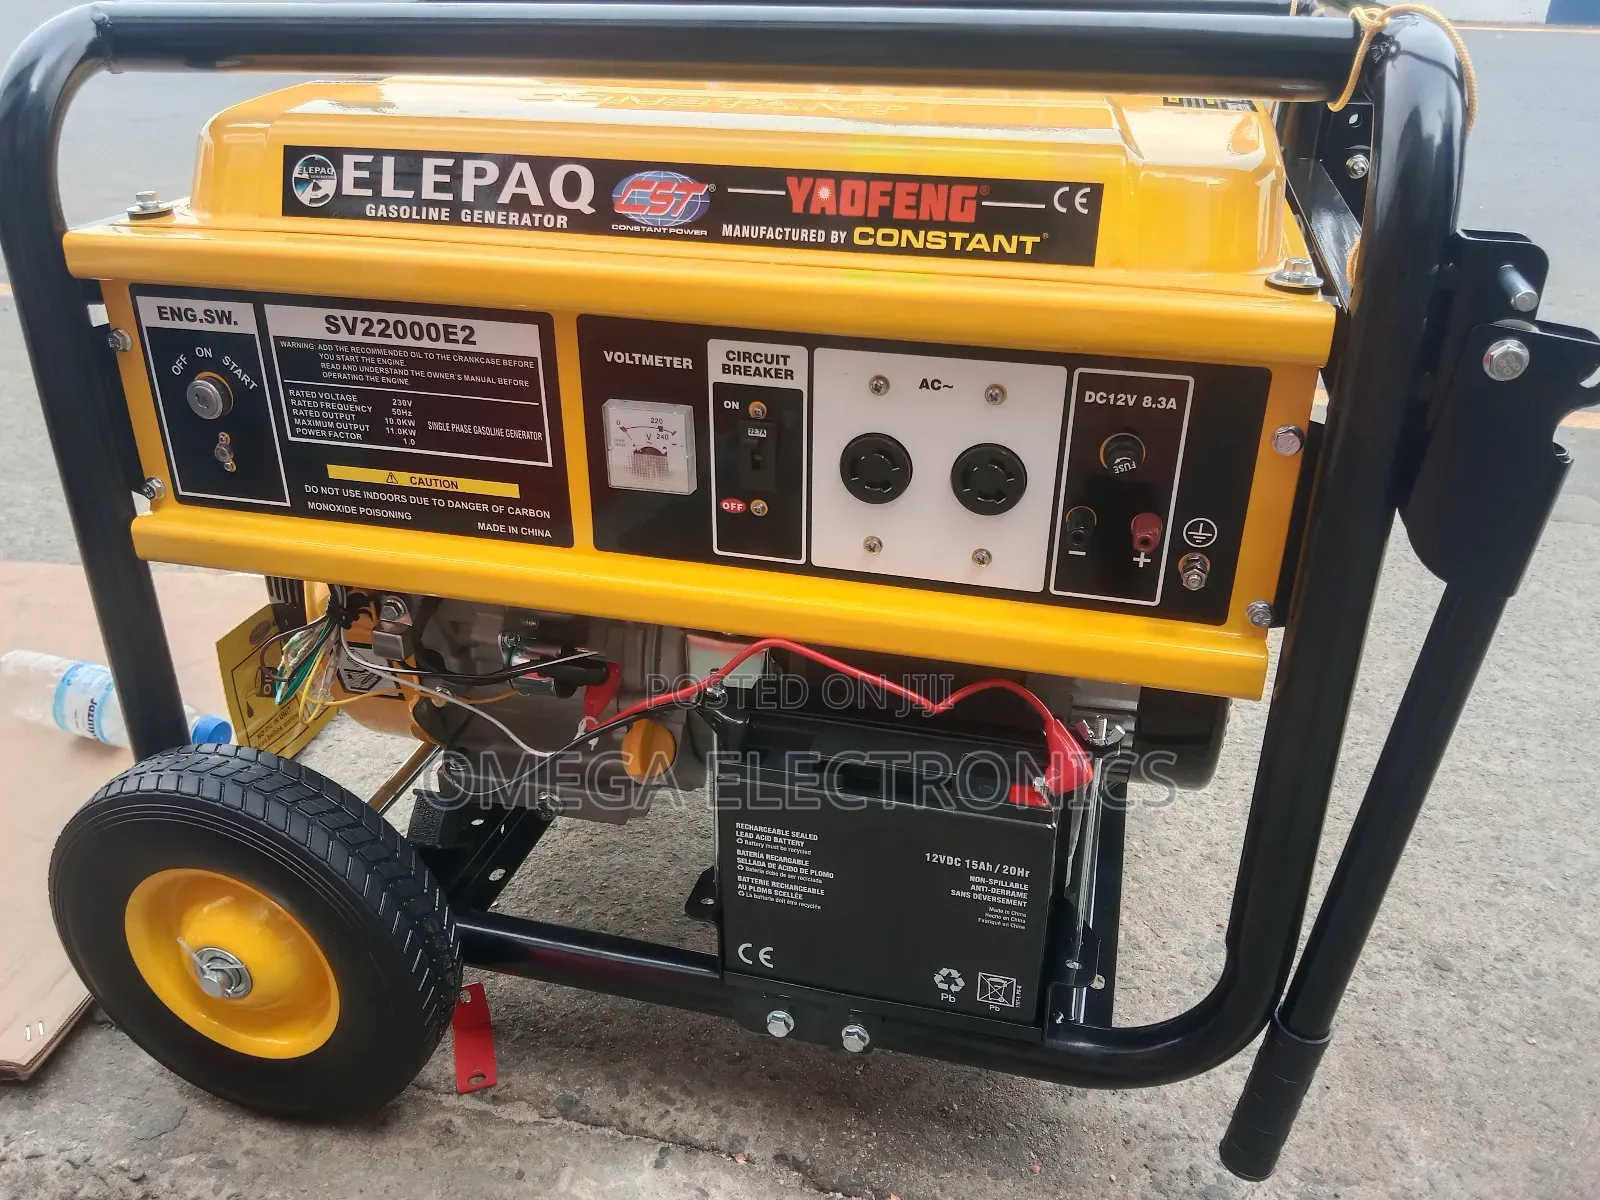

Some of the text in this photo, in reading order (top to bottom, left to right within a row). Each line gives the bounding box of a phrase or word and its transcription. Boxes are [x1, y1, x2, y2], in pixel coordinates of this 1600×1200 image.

[299, 166, 334, 176] ELEPAQ
[341, 154, 596, 214] ELEPAQ
[786, 176, 978, 223] YAOFENG
[1053, 186, 1091, 214] CE
[365, 203, 568, 229] GASOLINE GENERATOR
[722, 223, 1041, 255] MANUFACTURED BY CONSTANT
[157, 305, 238, 326] ENG.SW.
[324, 315, 477, 346] SV22000E2
[195, 346, 213, 359] ON
[280, 341, 317, 350] WARNING:
[334, 345, 350, 353] THE
[350, 346, 409, 358] RECOMMENDED
[410, 351, 423, 359] OIL
[423, 352, 435, 360] TO
[436, 353, 451, 361] THE
[452, 355, 501, 366] CRANKCASE
[502, 359, 535, 369] BEFORE
[319, 353, 408, 367] YOU START THE ENGINE.
[603, 350, 693, 370] VOLTMETER
[725, 350, 791, 366] CIRCUIT
[171, 354, 188, 376] OFF
[222, 355, 259, 391] START
[320, 362, 530, 387] READ AND UNDERSTAND THE OWNER'S MANUAL BEFORE
[721, 363, 794, 381] BREAKER
[322, 371, 412, 385] OPERATING THE ENGINE.
[289, 389, 413, 408] RATED VOLTAGE 230V
[290, 399, 413, 417] RATED FREQUENCY 50Hz
[723, 400, 740, 410] ON
[1084, 391, 1177, 410] DC12V 8.3A
[292, 408, 416, 427] RATED OUTPUT 10.0KW
[650, 417, 664, 425] 220
[294, 418, 417, 437] MAXIMUM OUTPUT 11.0KW
[296, 427, 416, 446] POWER FACTOR 1.0
[427, 420, 543, 441] SINGLE PHASE GASOLINE GENERATOR
[1112, 460, 1137, 474] FUSE
[410, 476, 459, 490] CAUTION
[304, 484, 551, 519] DO NOT USE INDOORS DUE TO DANGER OF CARBON
[307, 501, 412, 521] MONOXIDE POISONING
[722, 502, 744, 512] OFF
[477, 522, 552, 539] MADE IN CHINA
[735, 822, 819, 841] RECHARGEABLE SEALED
[735, 830, 805, 847] LEAD ACID BATTERY
[736, 857, 767, 868] SELLADA
[767, 862, 777, 870] DE
[810, 869, 834, 879] PLOMO
[765, 854, 810, 867] RECARGABLE
[925, 852, 1030, 878] 12VDC 15Ah / 20Hr
[737, 875, 825, 896] BATTERIE RECHARGEABLE
[748, 884, 773, 895] PLOMB
[969, 875, 1029, 891] NON-SPILLABLE
[970, 884, 1028, 900] ANTI-DERRAME
[950, 889, 971, 899] SANS
[737, 943, 774, 969] CE
[941, 992, 956, 1003] Pb
[989, 1004, 1001, 1012] Pb
